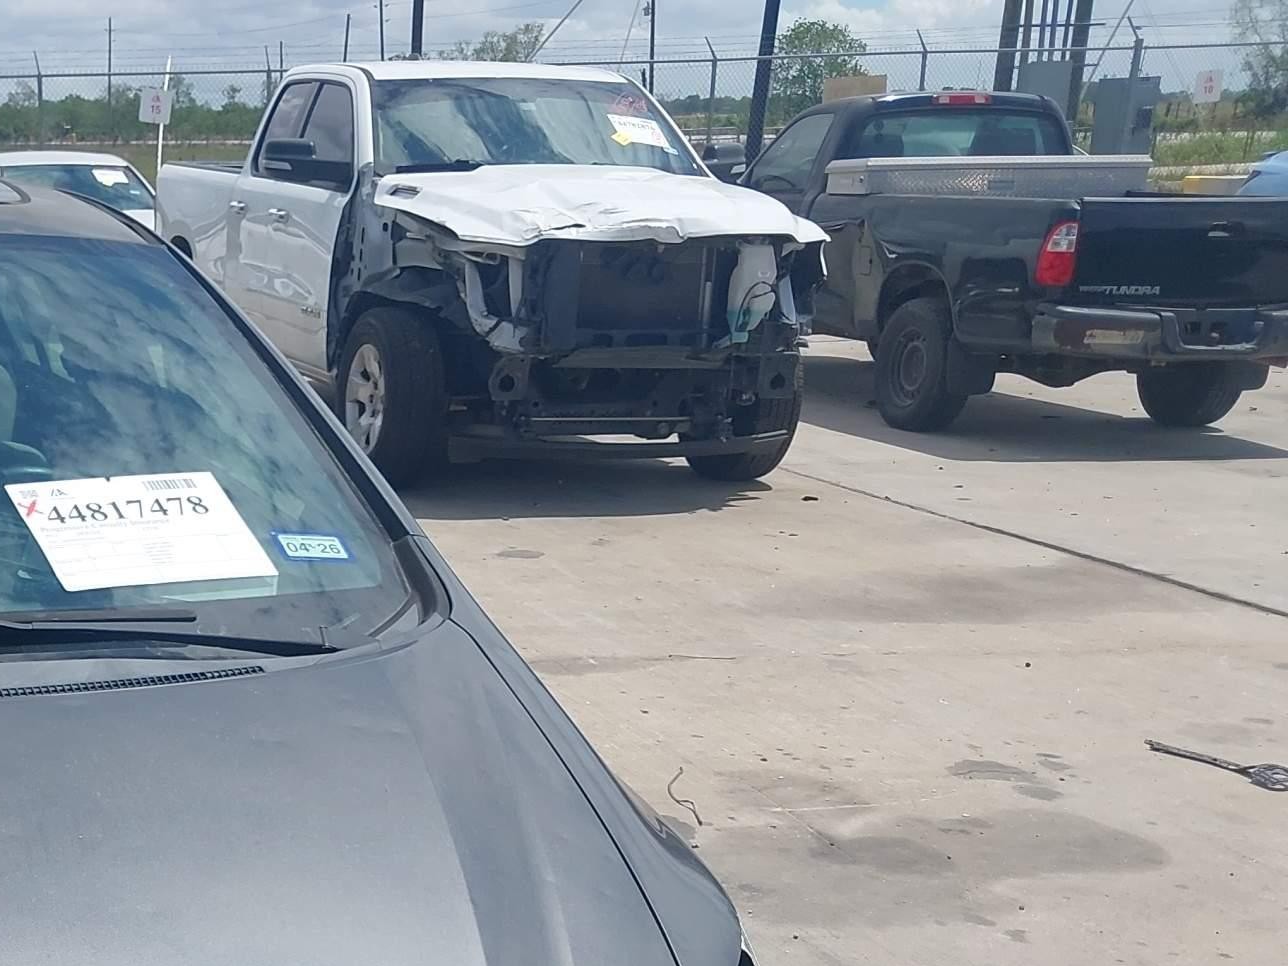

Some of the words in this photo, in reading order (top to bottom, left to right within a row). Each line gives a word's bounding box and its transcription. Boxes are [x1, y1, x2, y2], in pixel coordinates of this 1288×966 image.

[1104, 285, 1161, 295] TUNDRA
[47, 495, 210, 524] 44817478
[285, 542, 342, 554] 04-26
